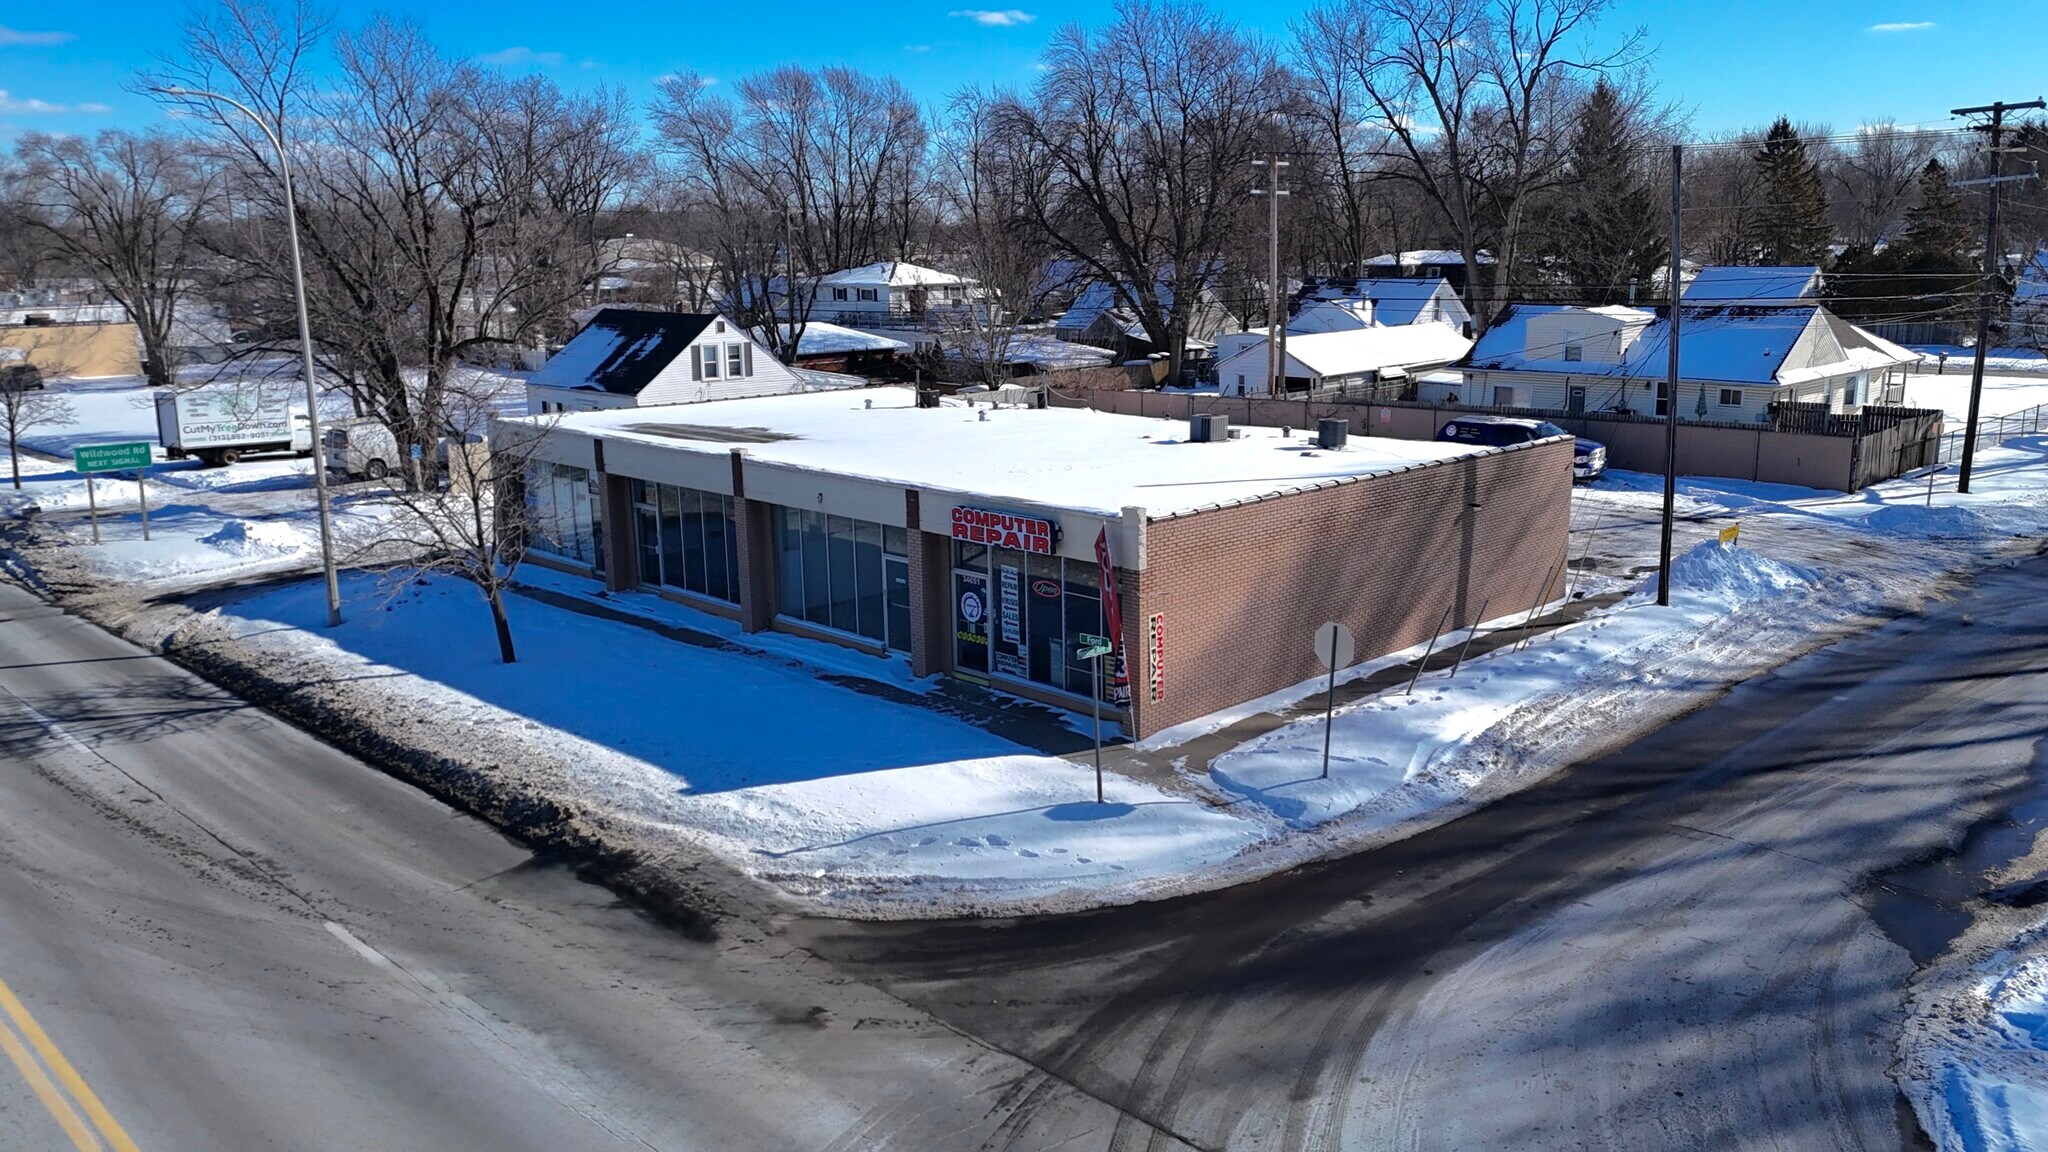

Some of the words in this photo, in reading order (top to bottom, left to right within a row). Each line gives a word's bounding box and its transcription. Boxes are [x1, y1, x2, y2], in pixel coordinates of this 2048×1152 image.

[79, 447, 130, 459] Wildwood
[132, 446, 145, 455] Rd
[86, 459, 108, 467] NEXT
[111, 457, 141, 466] SIGNAL
[952, 508, 1048, 536] COMPUTER
[953, 523, 1048, 552] REPAIR
[1002, 580, 1018, 590] REPAIR
[1034, 583, 1058, 595] Open
[1002, 611, 1019, 621] SALES
[1087, 635, 1102, 646] Ford
